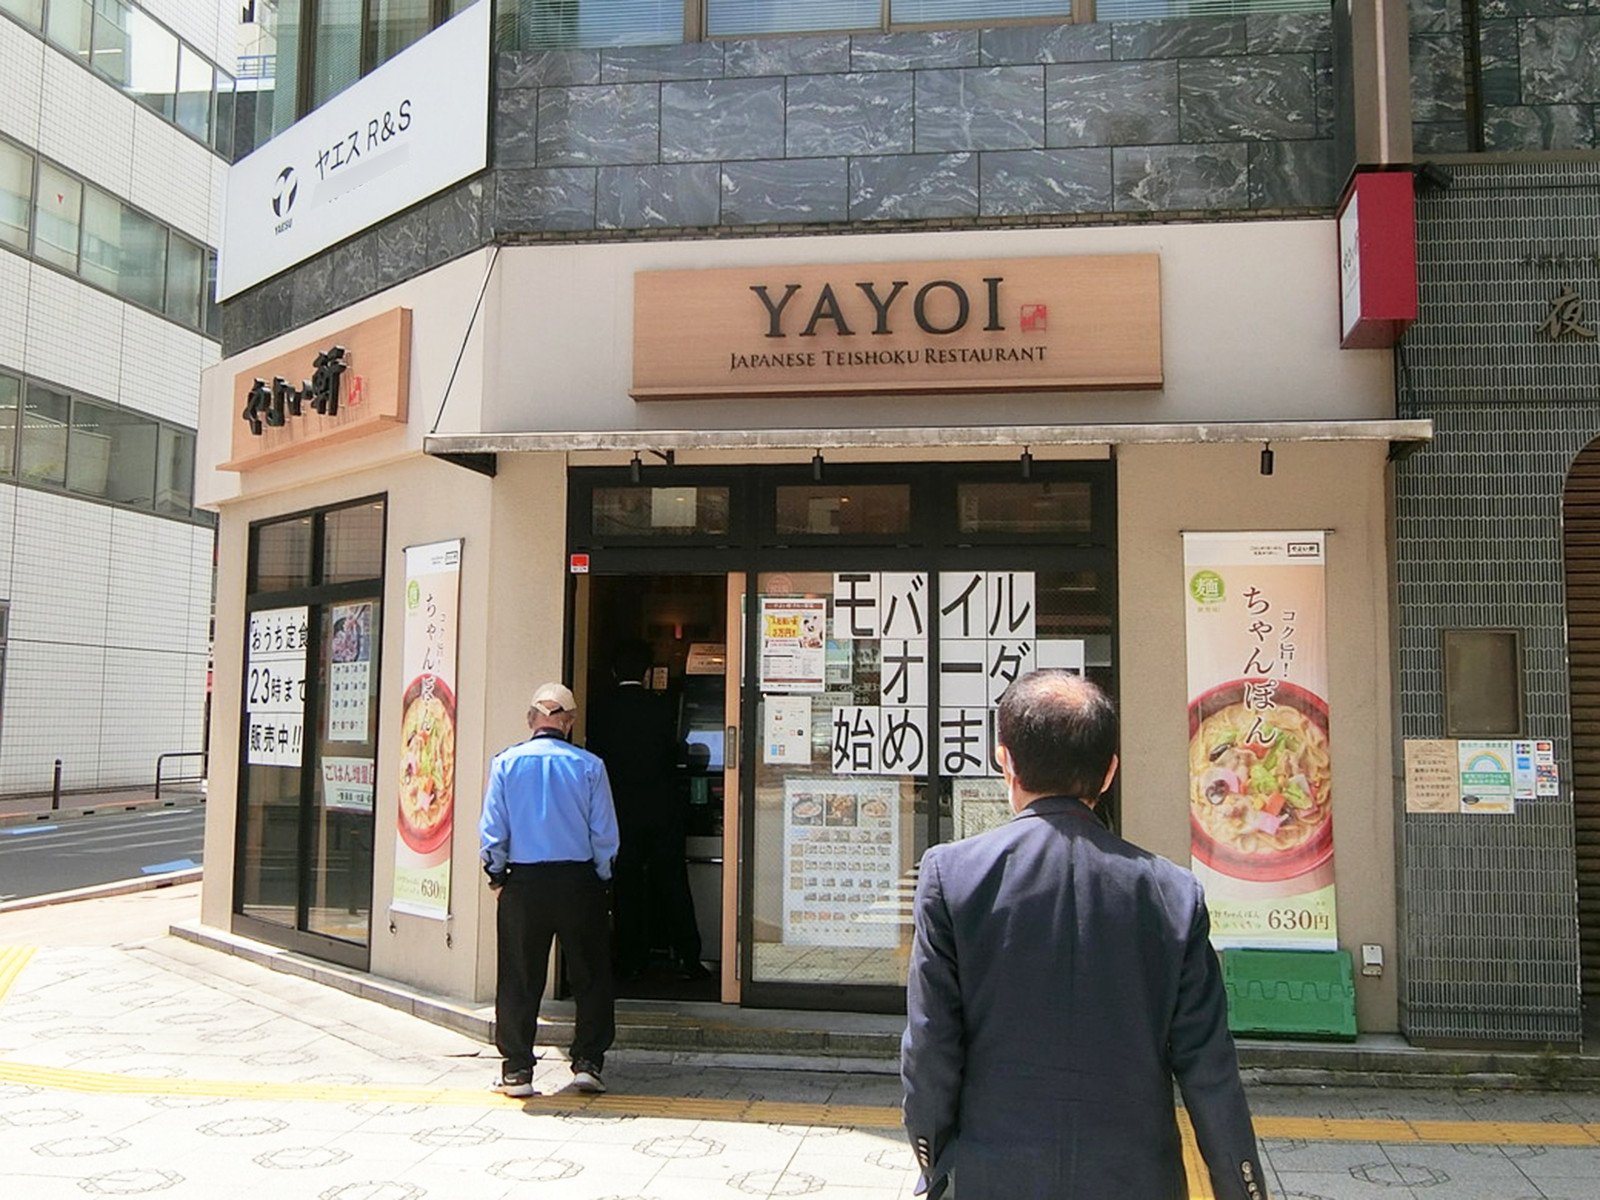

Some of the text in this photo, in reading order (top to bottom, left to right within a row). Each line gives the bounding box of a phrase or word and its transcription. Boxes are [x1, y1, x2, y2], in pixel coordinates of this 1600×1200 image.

[315, 99, 412, 180] ヤエス R&S
[750, 277, 1005, 338] YAYOI
[1536, 283, 1596, 339] 夜
[835, 573, 1031, 637] モバイル
[1243, 586, 1279, 745] ちゃんぽん
[1268, 909, 1329, 930] 630円
